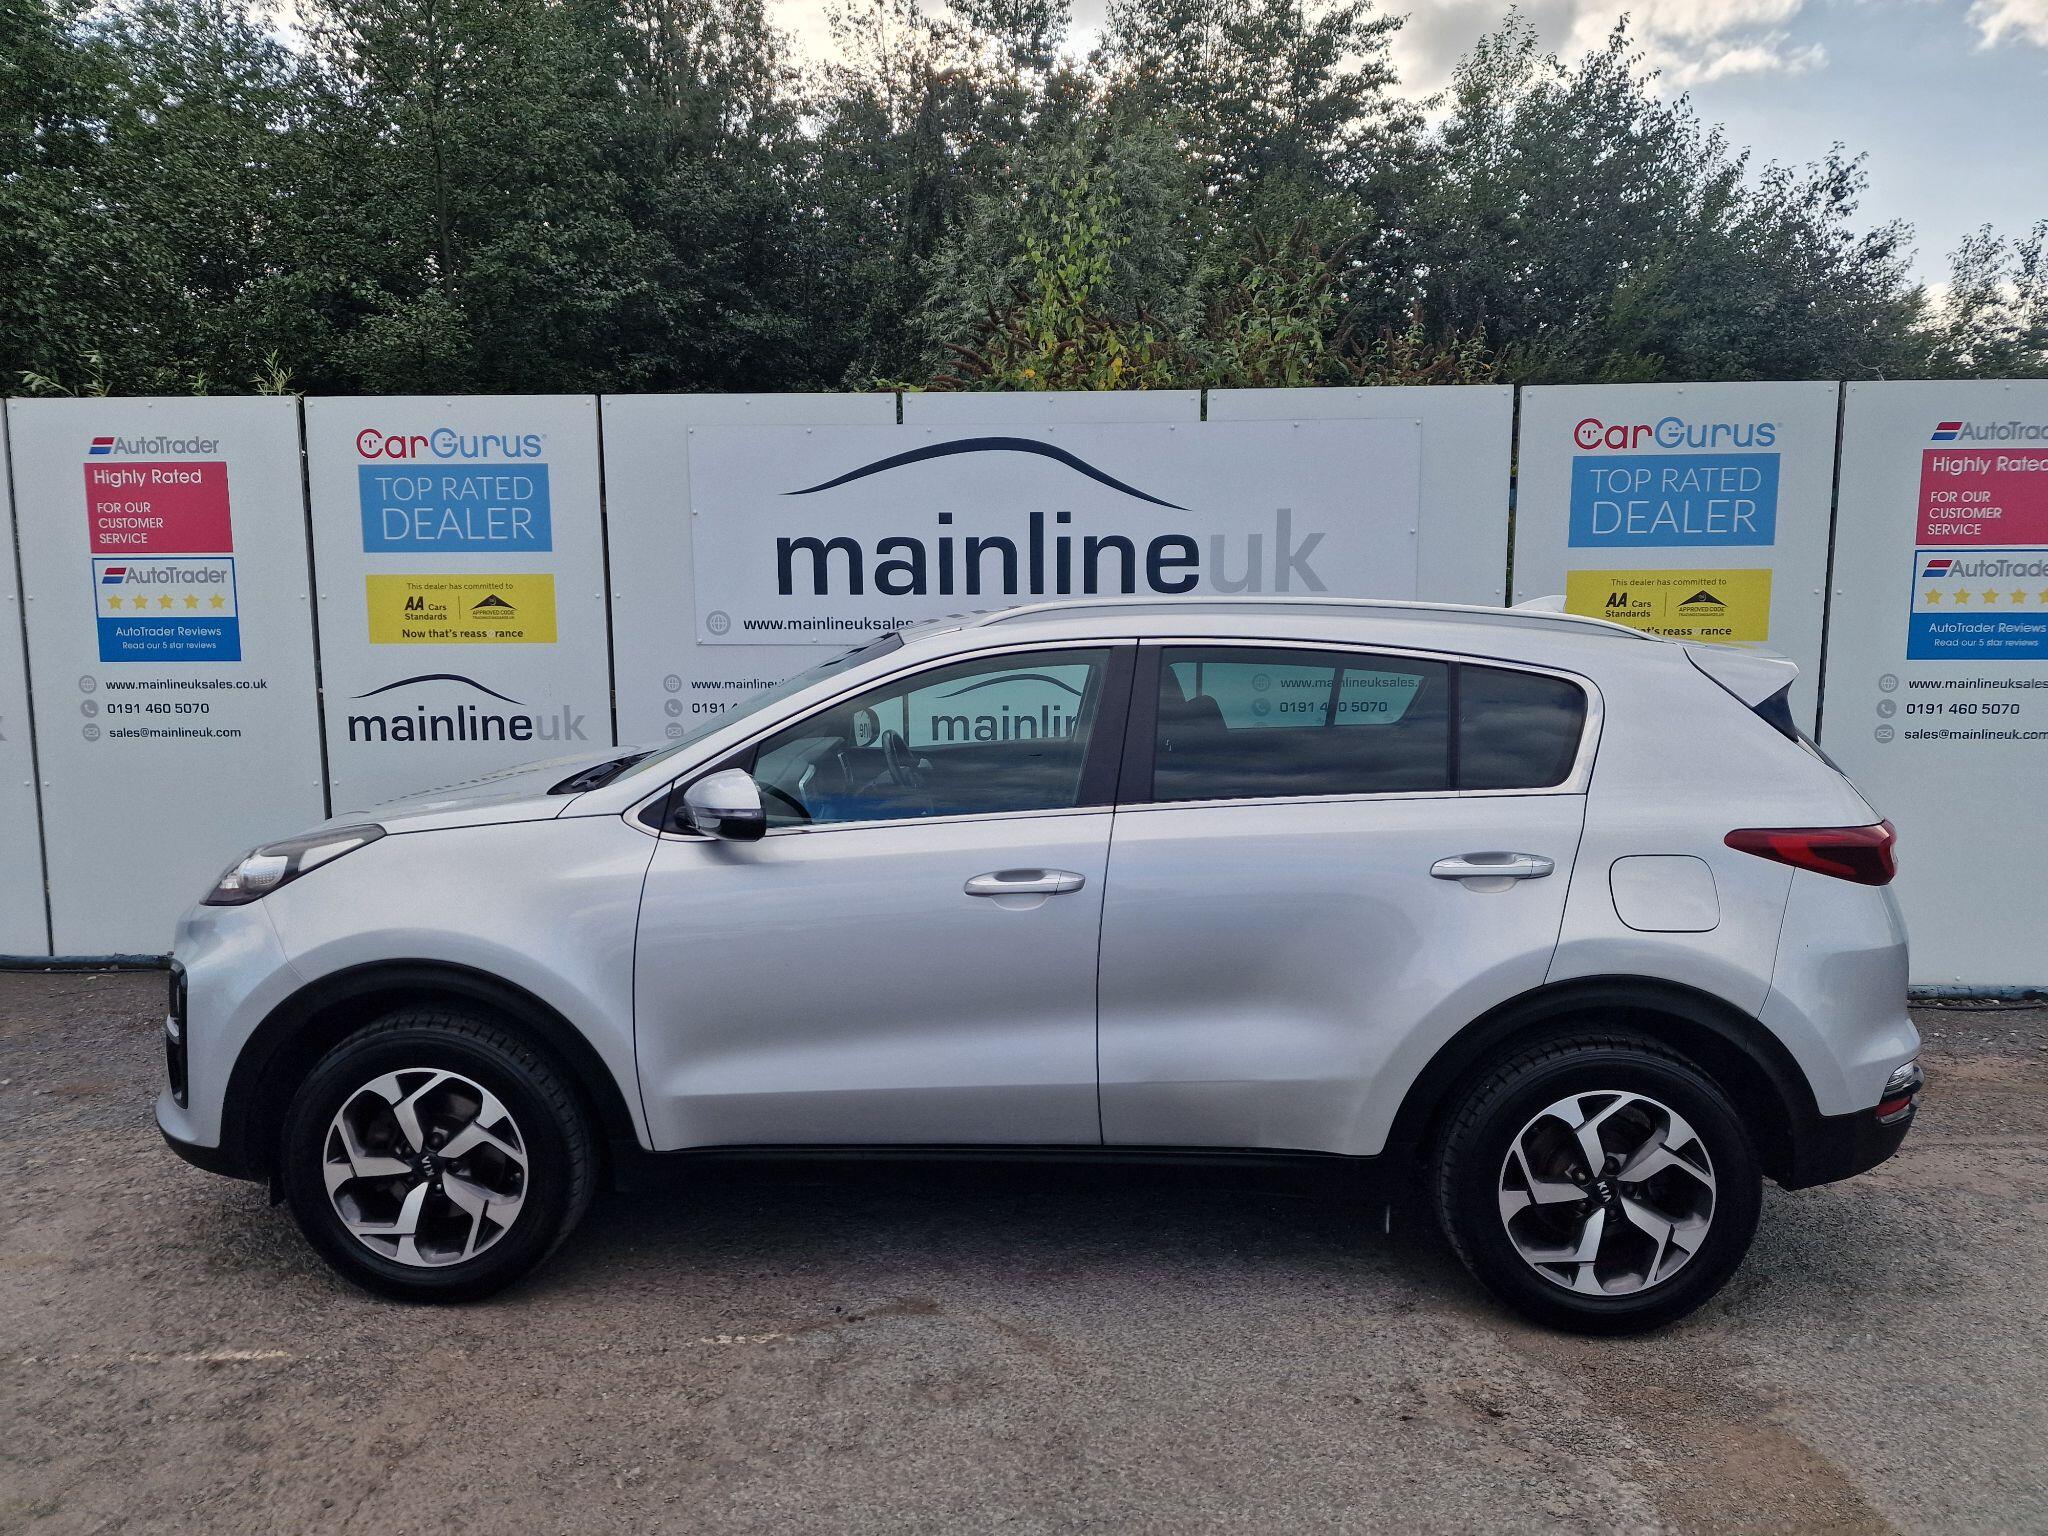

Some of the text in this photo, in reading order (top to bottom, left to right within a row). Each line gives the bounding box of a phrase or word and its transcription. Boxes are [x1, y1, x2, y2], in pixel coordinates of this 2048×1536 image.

[1573, 416, 1776, 450] CarGurus
[113, 436, 220, 456] AutoTrader
[356, 427, 543, 459] CarGurus
[1932, 456, 1992, 476] Highly
[93, 469, 203, 488] Highly Rated
[1590, 467, 1762, 494] TOP RATED
[374, 476, 534, 501] TOP RATED
[1930, 491, 1991, 503] FOR OUR
[97, 501, 152, 514] FOR OUR
[1929, 507, 2003, 519] CUSTOMER
[98, 517, 164, 529] CUSTOMER
[381, 507, 535, 541] DEALER
[1592, 500, 1758, 536] DEALER
[1927, 523, 1983, 535] SERVICE
[99, 532, 148, 544] SERVICE
[776, 508, 1328, 596] mainlineuk
[125, 567, 228, 584] AutoTrader
[1611, 579, 1628, 587] This
[1629, 579, 1655, 587] dealer
[404, 596, 447, 611] AA Cars
[1606, 592, 1652, 608] AA Cars
[404, 613, 448, 621] Standards
[1605, 610, 1651, 618] Standards
[115, 627, 222, 637] AutoTrader Reviews
[402, 629, 426, 638] Now
[428, 628, 458, 638] that's
[1929, 623, 2047, 633] AutoTrader Reviews
[122, 641, 145, 650] Read
[162, 642, 168, 650] 5
[169, 642, 184, 650] star
[186, 641, 217, 650] reviews
[1934, 638, 2039, 647] Read our 5 star reviews
[105, 678, 268, 691] www.mainlineuksales.co.uk
[107, 703, 210, 715] 0191 460 5070
[692, 702, 726, 714] 0191
[1279, 702, 1388, 713] 0191 40 5070
[1906, 703, 2020, 715] 0191 460 5070
[347, 704, 589, 742] mainlineuk
[109, 726, 242, 739] sales@mainlineuk.com
